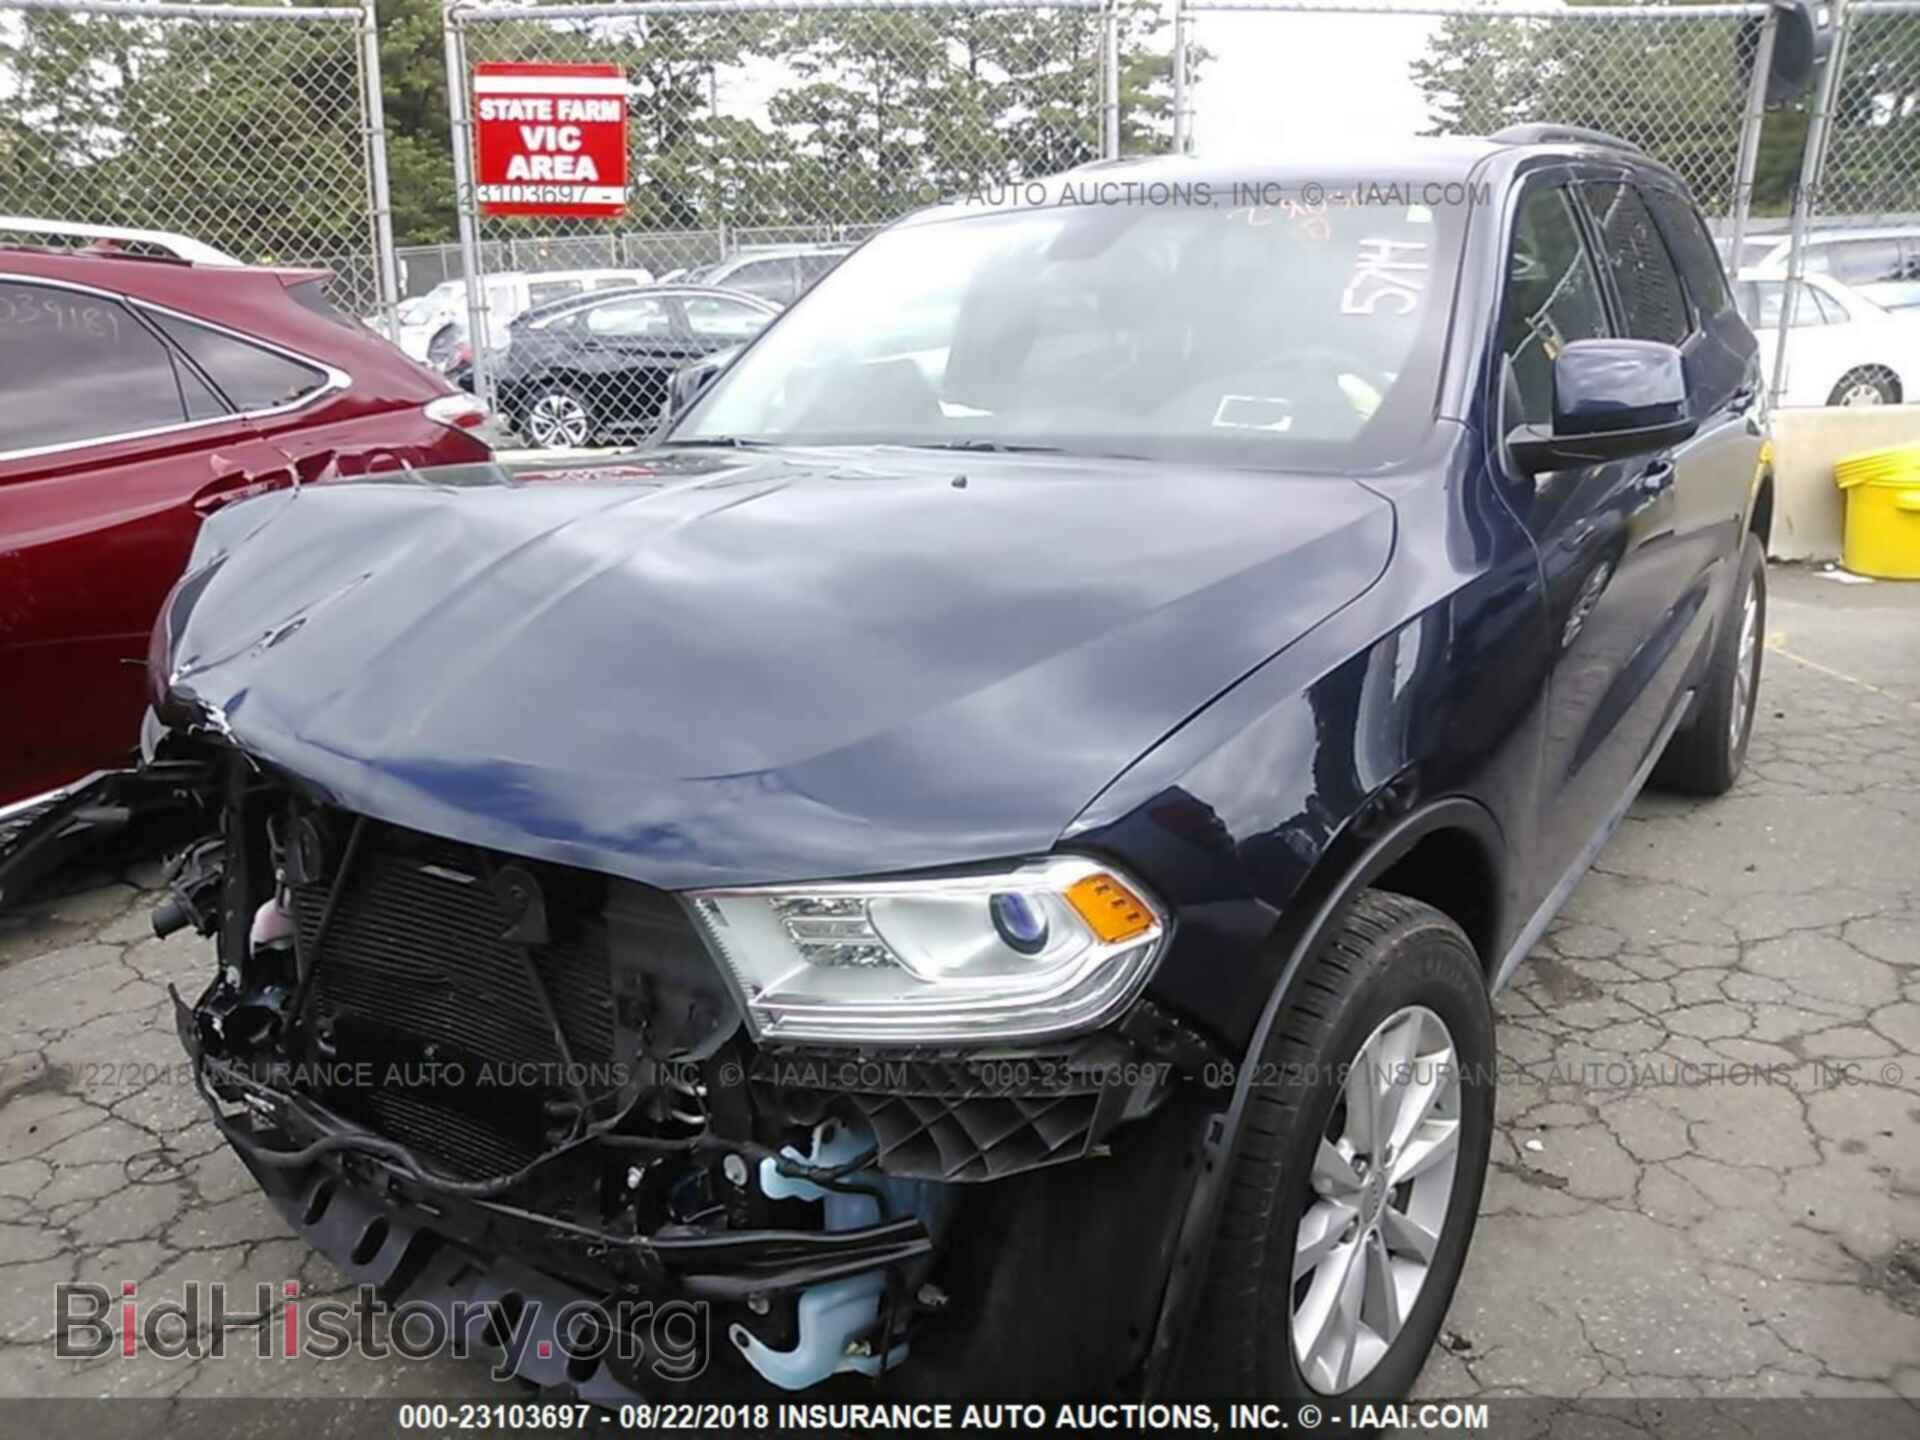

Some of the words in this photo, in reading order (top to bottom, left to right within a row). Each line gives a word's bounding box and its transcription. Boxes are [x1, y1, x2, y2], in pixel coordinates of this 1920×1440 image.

[479, 98, 553, 121] STATE
[557, 99, 621, 122] FARM
[519, 125, 583, 152] VIC
[505, 154, 600, 181] AREA
